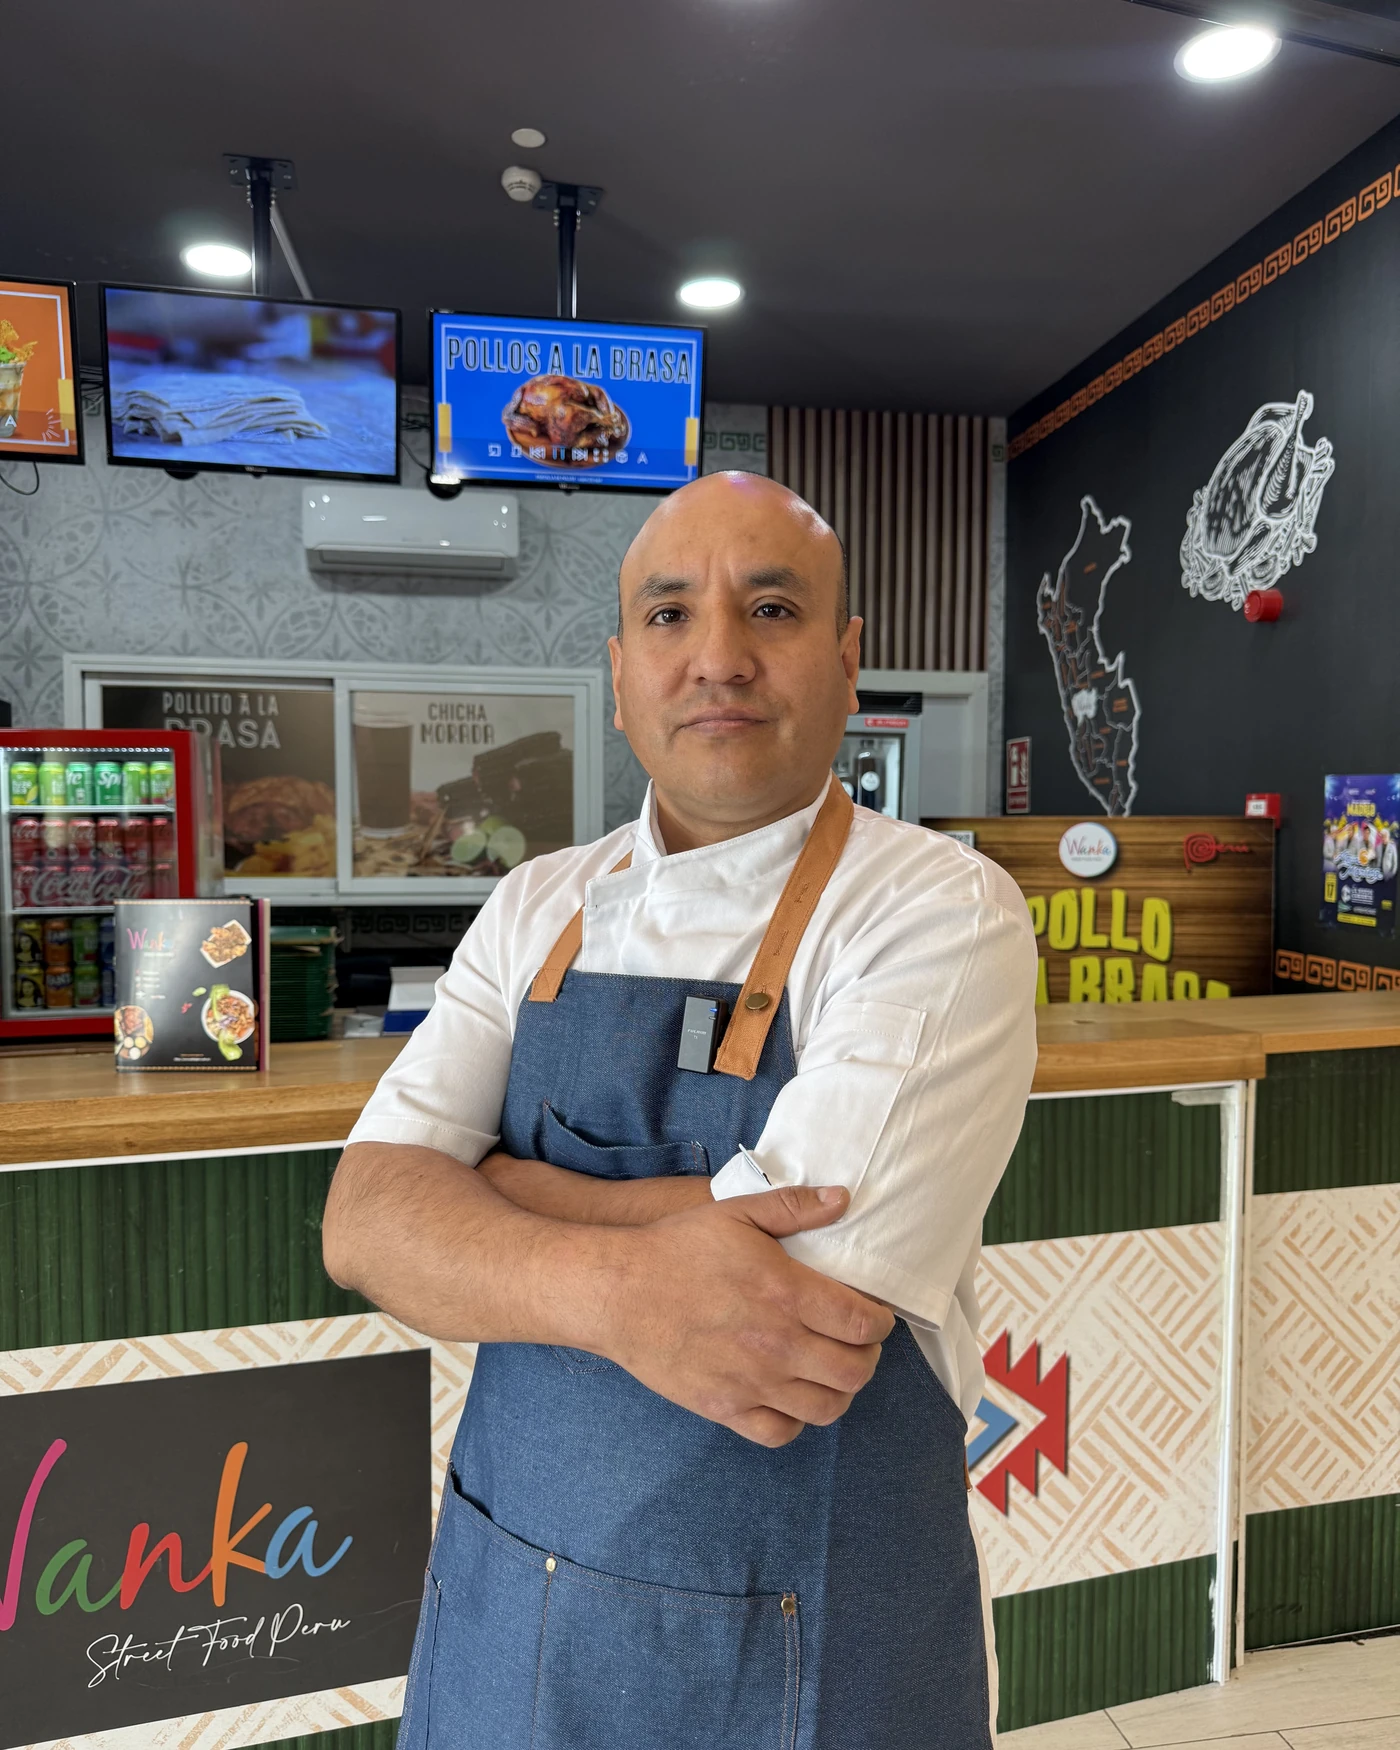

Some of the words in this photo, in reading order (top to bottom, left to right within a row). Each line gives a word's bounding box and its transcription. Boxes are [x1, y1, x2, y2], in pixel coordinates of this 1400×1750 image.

[446, 336, 541, 375] POLLOS
[547, 342, 564, 377] A
[572, 344, 603, 379] LA
[609, 346, 692, 384] BRASA
[162, 691, 232, 715] POLLITO
[239, 692, 251, 716] A
[257, 694, 279, 716] LA
[428, 702, 487, 721] CHICHA
[420, 722, 495, 745] MORADA
[1064, 835, 1112, 856] Wanka
[1069, 955, 1231, 1003] BRA
[86, 1624, 200, 1689] Street
[187, 1616, 266, 1668] Food
[269, 1603, 352, 1658] Peru
